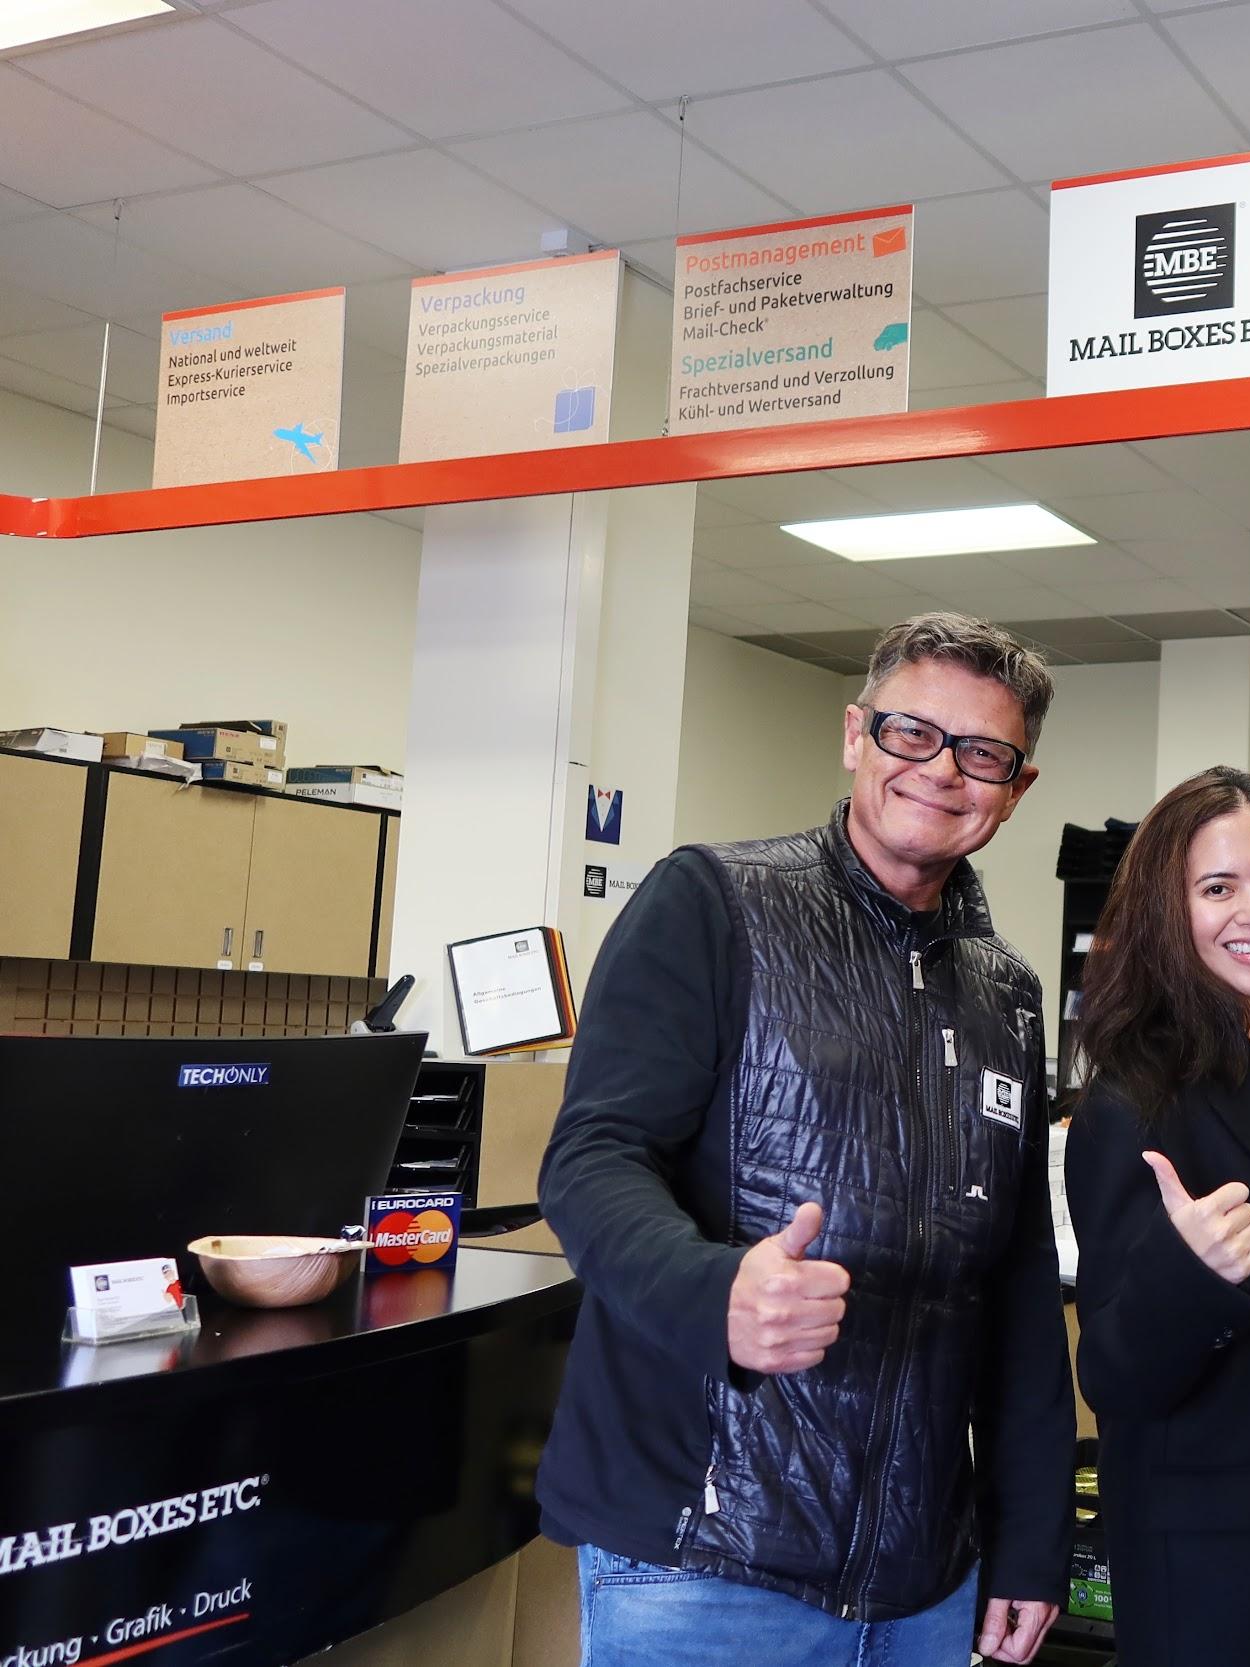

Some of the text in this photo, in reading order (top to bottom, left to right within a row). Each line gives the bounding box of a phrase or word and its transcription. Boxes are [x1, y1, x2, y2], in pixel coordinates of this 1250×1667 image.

[686, 233, 866, 274] Postmanagement
[1153, 246, 1218, 276] MBE
[420, 284, 526, 314] Verpackung
[684, 272, 802, 299] Postfachservice
[684, 282, 894, 320] Brief- und Paketverwaltung
[169, 321, 234, 346] Versand
[418, 308, 551, 338] Verpackungsservice
[168, 339, 297, 369] National und weltweit
[416, 325, 559, 358] Verpackungsmaterial
[1069, 331, 1143, 362] MAIL
[1148, 320, 1236, 353] BOXES
[414, 346, 557, 378] Spezialverpackungen
[681, 338, 833, 378] Spezialversand
[168, 360, 293, 388] Express-Kurierservice
[680, 365, 894, 400] Frachtversand und Verzollung
[166, 384, 246, 406] Importservice
[679, 390, 842, 420] Kühl- und Wertversand
[296, 788, 336, 796] PELEMAN
[609, 880, 626, 889] MAIL
[377, 1198, 454, 1210] EUROCARD
[375, 1228, 452, 1247] MasterCard
[88, 1493, 198, 1552] BOXES
[106, 1604, 174, 1645] Grafik
[194, 1578, 252, 1618] Druck
